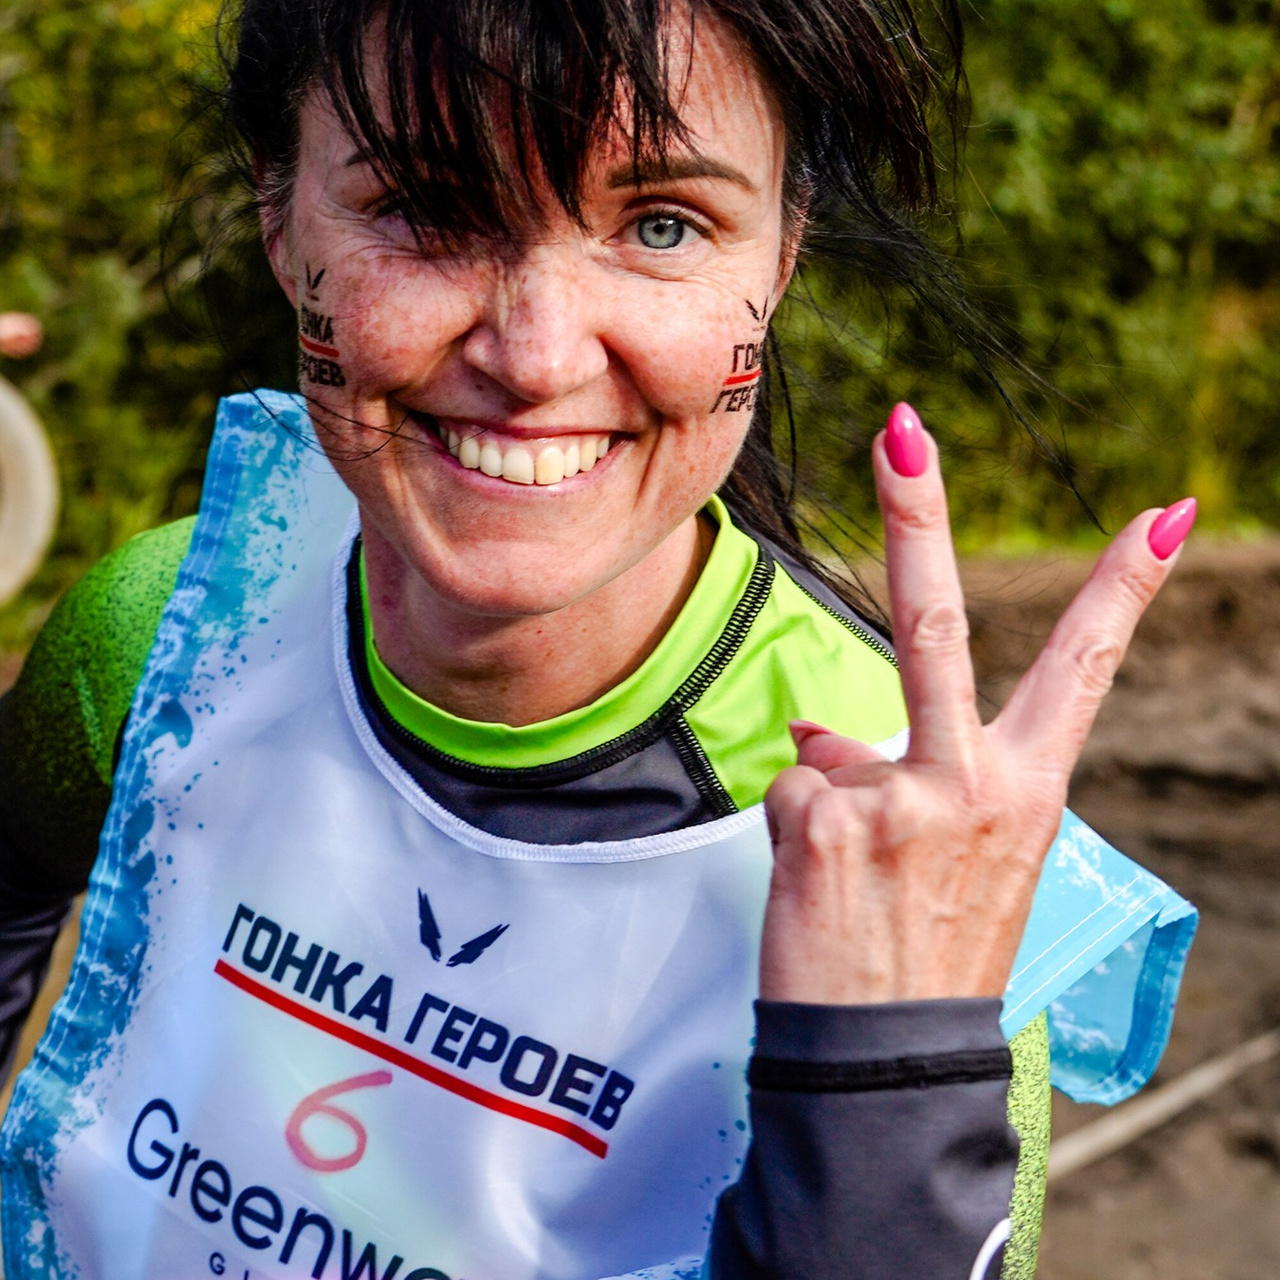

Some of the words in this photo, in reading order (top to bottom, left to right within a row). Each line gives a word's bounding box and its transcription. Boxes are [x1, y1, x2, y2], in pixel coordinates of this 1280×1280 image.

[221, 902, 392, 1033] ГОНКА
[404, 992, 635, 1131] ГЕРОЕВ
[285, 1070, 393, 1174] 6
